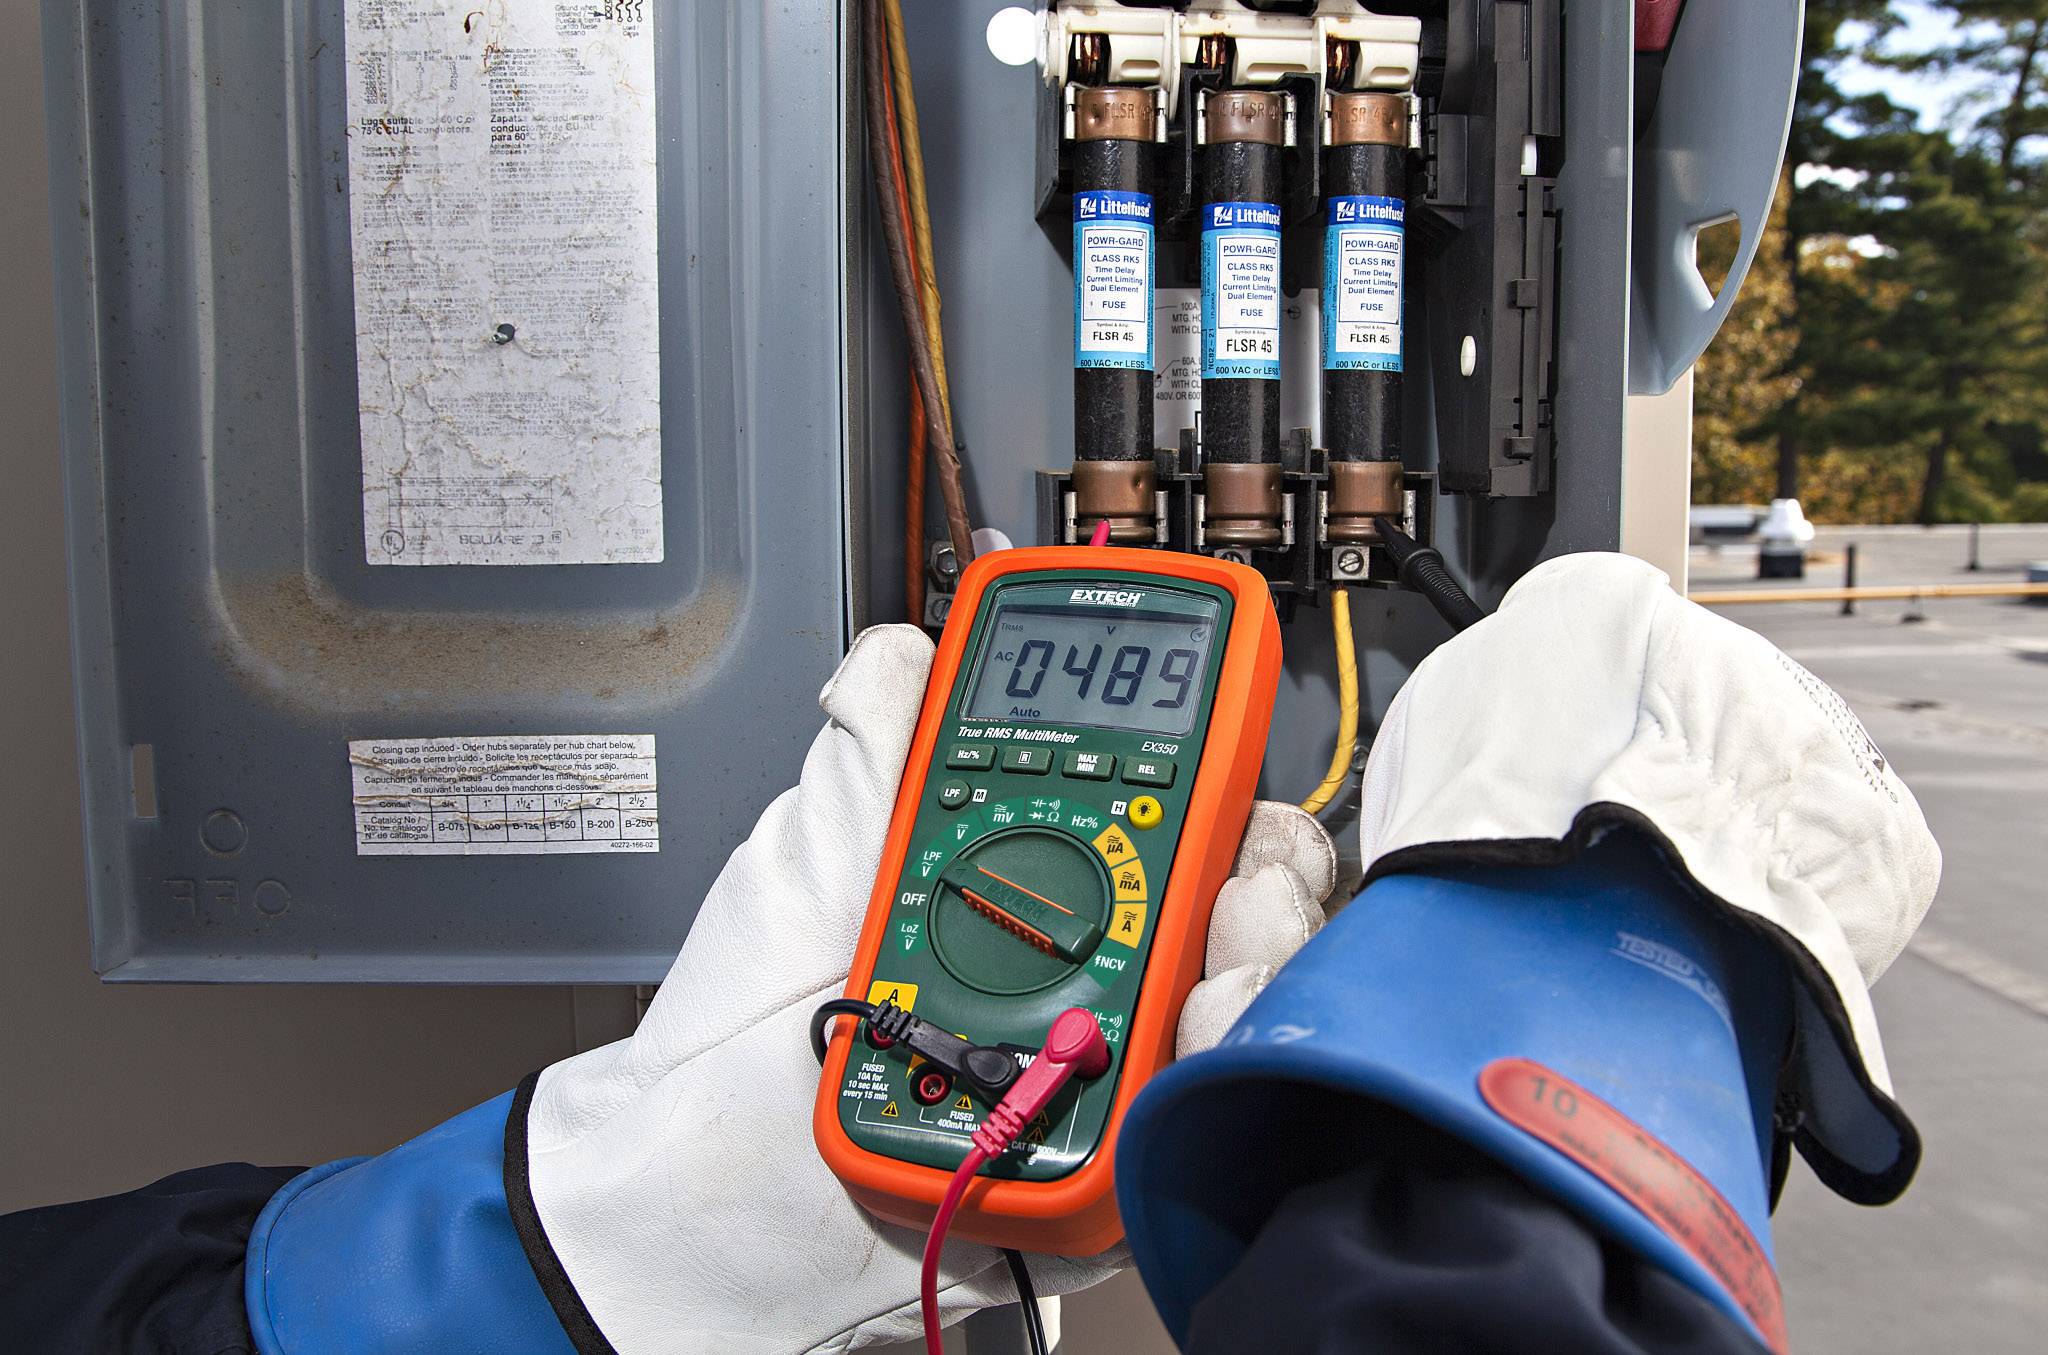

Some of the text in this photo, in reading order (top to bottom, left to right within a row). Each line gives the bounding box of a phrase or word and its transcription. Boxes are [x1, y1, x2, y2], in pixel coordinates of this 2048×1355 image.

[1230, 101, 1265, 118] FLSR
[361, 117, 384, 127] Lugs
[361, 126, 415, 135] 75°C CU-AL
[491, 134, 512, 143] para
[1101, 200, 1150, 217] Littelfuse
[1359, 204, 1403, 221] Littelfuse
[1237, 209, 1280, 225] Littelfuse
[1088, 237, 1143, 246] POWR-GARD
[1346, 240, 1398, 250] POWR-GARD
[1224, 246, 1276, 255] POWR-GARD
[1091, 254, 1139, 263] CLASS RK5
[1381, 259, 1395, 267] RK5
[1115, 266, 1135, 275] Delay
[1228, 263, 1273, 272] CLASS RK5
[1253, 275, 1270, 283] Delay
[1374, 270, 1391, 279] Delay
[1115, 276, 1142, 285] Limiting
[1374, 280, 1398, 288] Limiting
[1110, 285, 1138, 293] Element
[1253, 284, 1276, 293] Limiting
[1368, 288, 1394, 296] Element
[1247, 293, 1272, 301] Element
[1361, 303, 1383, 311] FUSE
[1241, 309, 1263, 317] FUSE
[1172, 314, 1189, 323] MTG.
[1171, 325, 1190, 334] WITH
[1093, 332, 1133, 341] FLSR 45
[1351, 334, 1390, 343] FLSR 45
[1227, 339, 1272, 353] FLSR 45
[1125, 360, 1144, 368] LESS
[1383, 361, 1399, 370] LESS
[1172, 368, 1189, 377] MTG.
[1216, 366, 1229, 374] 600
[1232, 366, 1250, 374] VAC
[1264, 367, 1279, 375] LESS
[1171, 380, 1189, 389] WITH
[1176, 392, 1187, 400] OR
[1071, 590, 1141, 604] EXTECH
[1001, 622, 1116, 635] TRMS V
[994, 639, 1199, 708] AC 0489
[1009, 706, 1041, 718] Auto
[957, 726, 1080, 743] True RMS MultiMeter
[372, 746, 402, 755] Closing
[462, 743, 485, 751] Order
[487, 742, 507, 750] hubs
[510, 742, 551, 752] separately
[554, 743, 567, 751] per
[610, 741, 636, 749] below.
[1141, 741, 1178, 755] EX350
[447, 754, 478, 762] incluido
[485, 753, 515, 761] Solicite
[531, 752, 582, 762] receptáculos
[584, 753, 598, 761] por
[957, 750, 980, 759] Hz/%
[522, 763, 538, 771] que
[1076, 763, 1095, 773] MIN
[1078, 753, 1156, 775] MAX REL
[364, 775, 406, 784] Capuchon
[490, 773, 540, 781] Commander
[600, 772, 649, 781] séparément
[463, 785, 493, 793] tableau
[944, 788, 1123, 812] LPF H
[371, 816, 402, 825] Catalog
[993, 811, 1015, 823] mV
[1071, 815, 1098, 829] Hz%
[438, 823, 465, 831] B-075
[550, 821, 576, 829] B-150
[587, 820, 615, 828] B-200
[625, 819, 653, 828] B-250
[923, 851, 942, 861] LPF
[1118, 878, 1140, 892] mA
[901, 892, 927, 906] OFF
[901, 923, 919, 933] LoZ
[1100, 955, 1126, 972] NCV
[887, 989, 899, 1003] A
[862, 1063, 885, 1073] FUSED
[858, 1072, 883, 1082] 10A for
[848, 1080, 857, 1088] 10
[872, 1083, 889, 1092] MAX
[843, 1089, 888, 1100] every 15 min
[1531, 1074, 1578, 1120] 10
[950, 1111, 974, 1121] FUSED
[937, 1119, 963, 1129] 400mA
[1011, 1141, 1027, 1150] CAT
